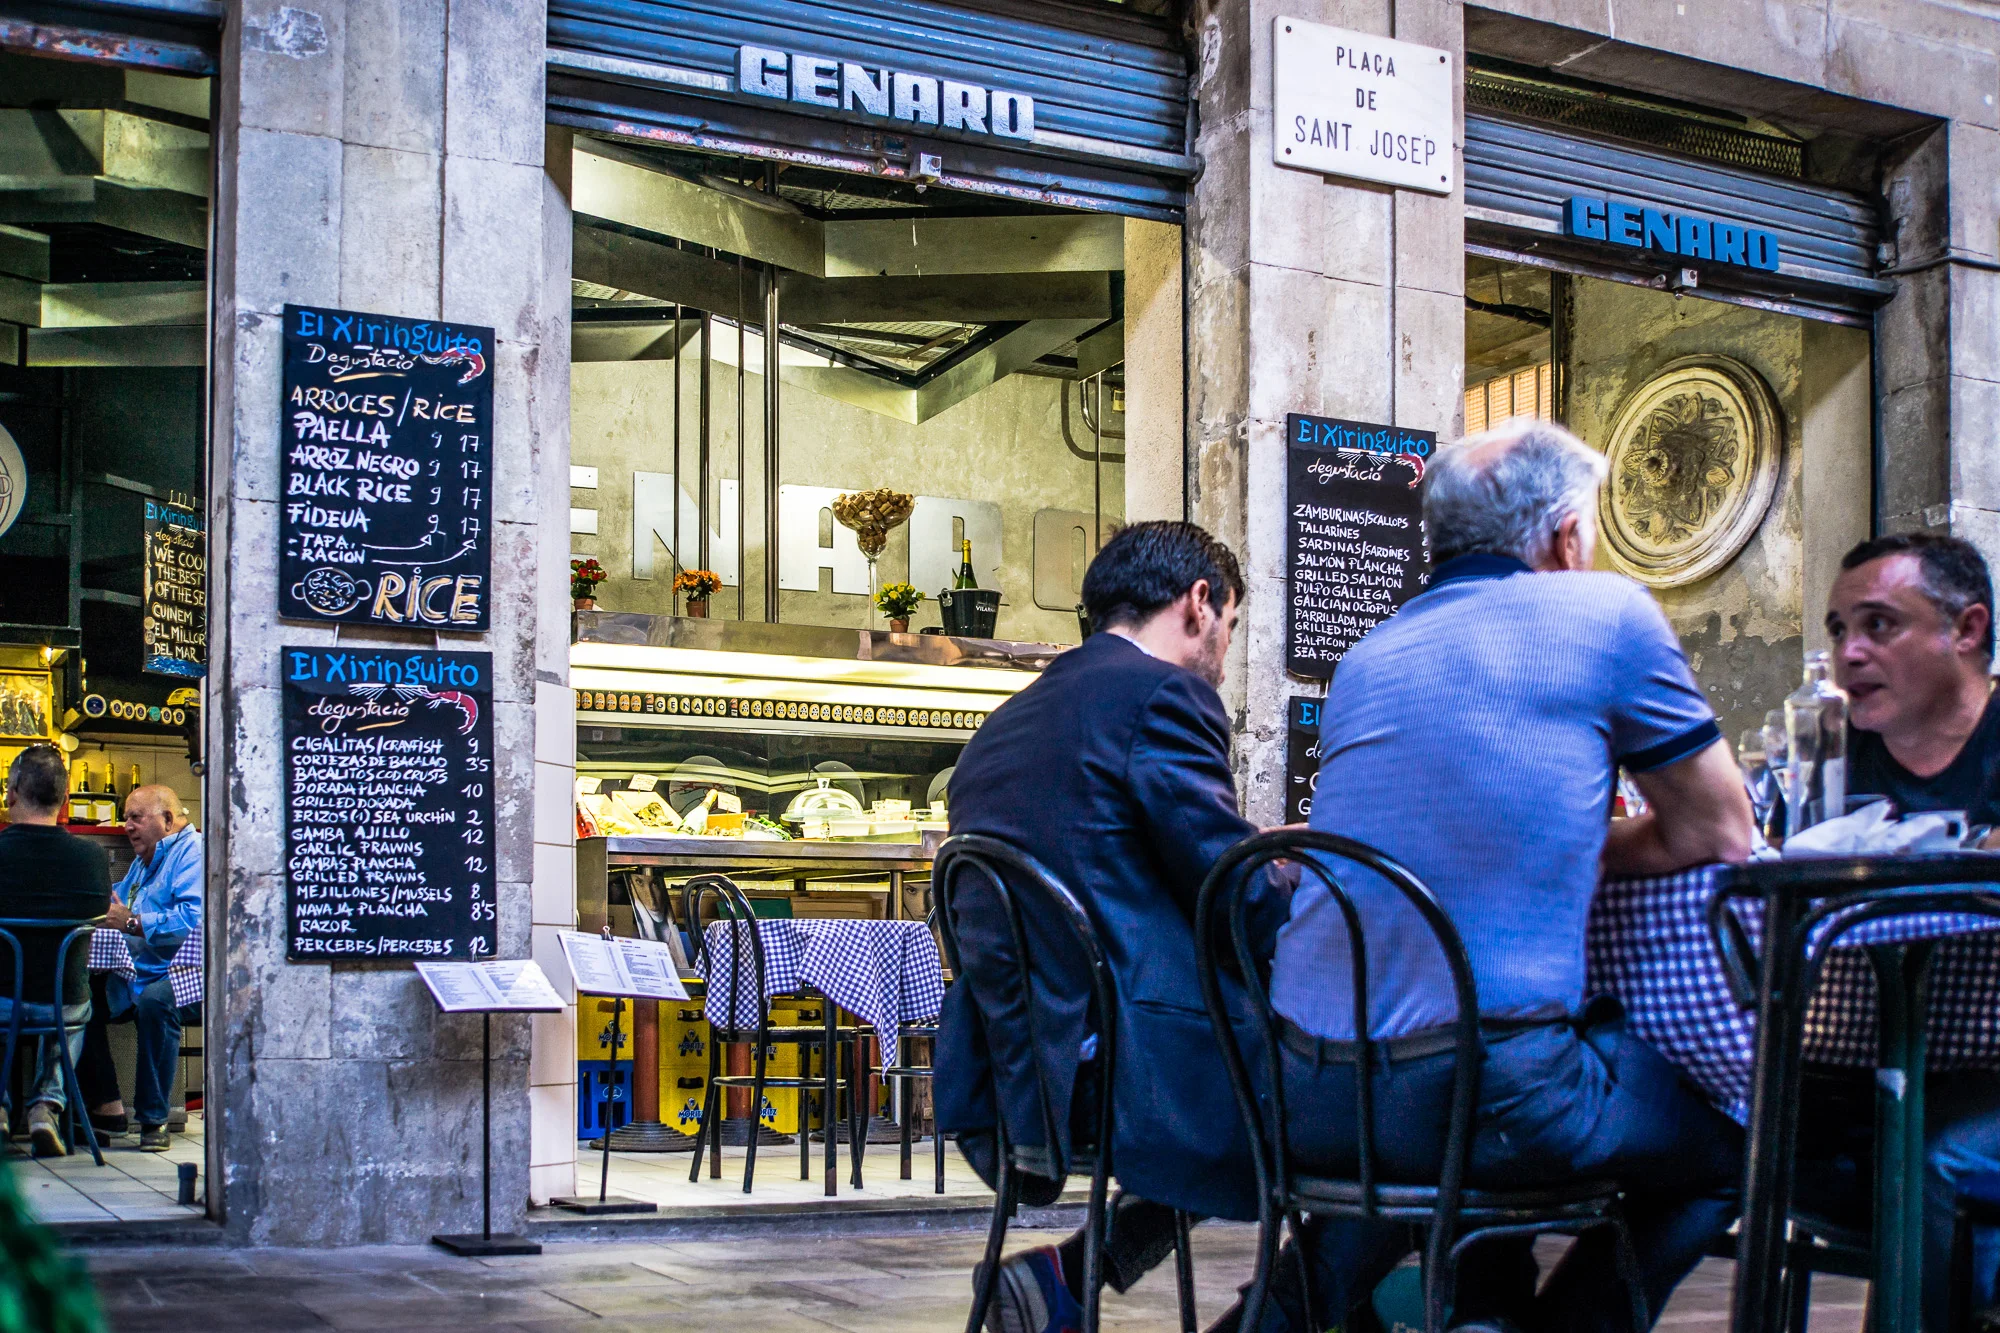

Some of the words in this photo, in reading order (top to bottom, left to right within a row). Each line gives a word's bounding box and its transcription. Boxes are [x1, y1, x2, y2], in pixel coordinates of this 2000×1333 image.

[1336, 46, 1395, 77] PLAÇA
[737, 45, 1034, 141] GENARO
[1356, 88, 1376, 111] DE
[1295, 115, 1352, 151] SANT
[1370, 129, 1436, 166] JOSEP
[1566, 196, 1778, 271] GENARO
[297, 312, 324, 336] El
[333, 315, 482, 355] Xiringuito
[294, 411, 391, 448] PAELLA
[460, 435, 479, 452] 17
[1297, 420, 1318, 443] El
[1322, 426, 1429, 457] Xiringuito
[290, 445, 354, 471] ARROZ
[357, 450, 420, 481] NEGRO
[460, 460, 483, 478] 17
[287, 472, 350, 498] BLACK
[462, 486, 482, 509] 17
[460, 517, 481, 539] 17
[154, 545, 176, 565] WE
[1295, 552, 1345, 570] SALMÓN
[1347, 558, 1404, 577] PLANCHA
[154, 562, 178, 583] THE
[179, 568, 205, 588] BEST
[1294, 569, 1349, 585] GRILLED
[1349, 573, 1402, 589] SALMON
[154, 580, 170, 600] OF
[1294, 582, 1331, 597] PULPO
[1331, 585, 1392, 602] GALLEGA
[1293, 594, 1351, 612] GALICIAN
[1352, 601, 1399, 617] OCTOPUS
[1294, 608, 1357, 628] PARRILLADA
[154, 621, 170, 639] EL
[1294, 621, 1341, 636] GRILLED
[1293, 633, 1346, 648] SALPICON
[153, 642, 173, 656] DEL
[175, 645, 200, 663] MAR
[1293, 646, 1317, 660] SEA
[289, 651, 318, 681] El
[325, 652, 479, 687] Xiringuito
[657, 699, 726, 714] GENARO
[468, 737, 480, 754] 9
[292, 755, 368, 768] CORTEZAS
[368, 756, 388, 767] DE
[388, 757, 448, 770] BACALAO
[376, 770, 401, 781] COD
[403, 770, 449, 784] CRUSTS
[292, 782, 357, 797] DORADA
[359, 782, 428, 798] PLANCHA
[461, 784, 484, 799] 10
[292, 796, 356, 810] GRILLED
[357, 797, 416, 810] DORADA
[293, 810, 348, 824] ERIZOS
[373, 811, 401, 824] SEA
[466, 809, 484, 825] 2
[292, 827, 345, 843] GAMBA
[354, 826, 410, 840] AJILLO
[461, 829, 486, 844] 12
[295, 843, 356, 856] GARLIC
[360, 841, 425, 857] PRAWNS
[289, 857, 348, 871] GAMBAS
[350, 856, 417, 872] PLANCHA
[464, 856, 488, 873] 12
[292, 871, 359, 883] GRILLED
[365, 871, 426, 884] PRAWNS
[296, 884, 453, 904] MEJILLONES/MUSSELS
[470, 883, 480, 899] 8
[357, 902, 428, 918] PLANCHA
[299, 919, 357, 933] RAZOR
[294, 937, 454, 956] PERCEBES/PERCEBES
[469, 936, 490, 955] 12
